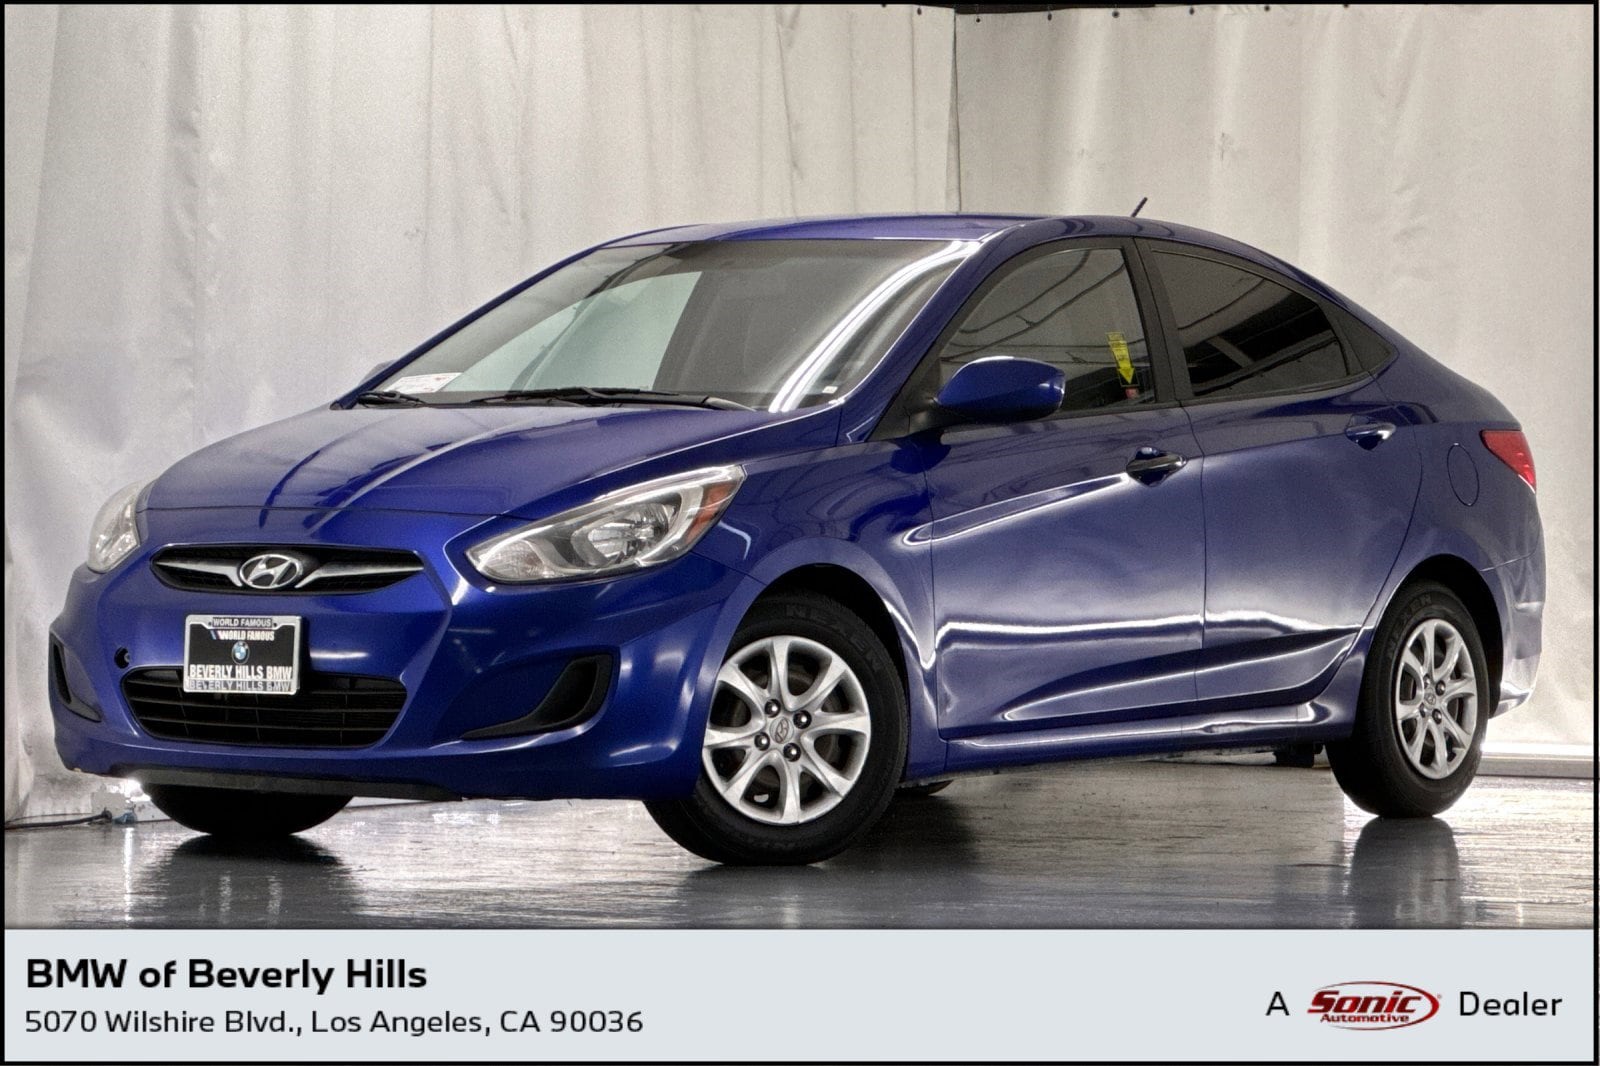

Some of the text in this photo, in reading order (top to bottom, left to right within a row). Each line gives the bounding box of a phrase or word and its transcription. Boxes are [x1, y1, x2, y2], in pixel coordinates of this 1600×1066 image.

[213, 618, 271, 627] WORLD FAMOUS
[219, 630, 275, 641] WORLD FAMOUS
[189, 664, 293, 680] BEVERLY HILLS BMW
[190, 680, 290, 692] BEVERLY HILLS BMW
